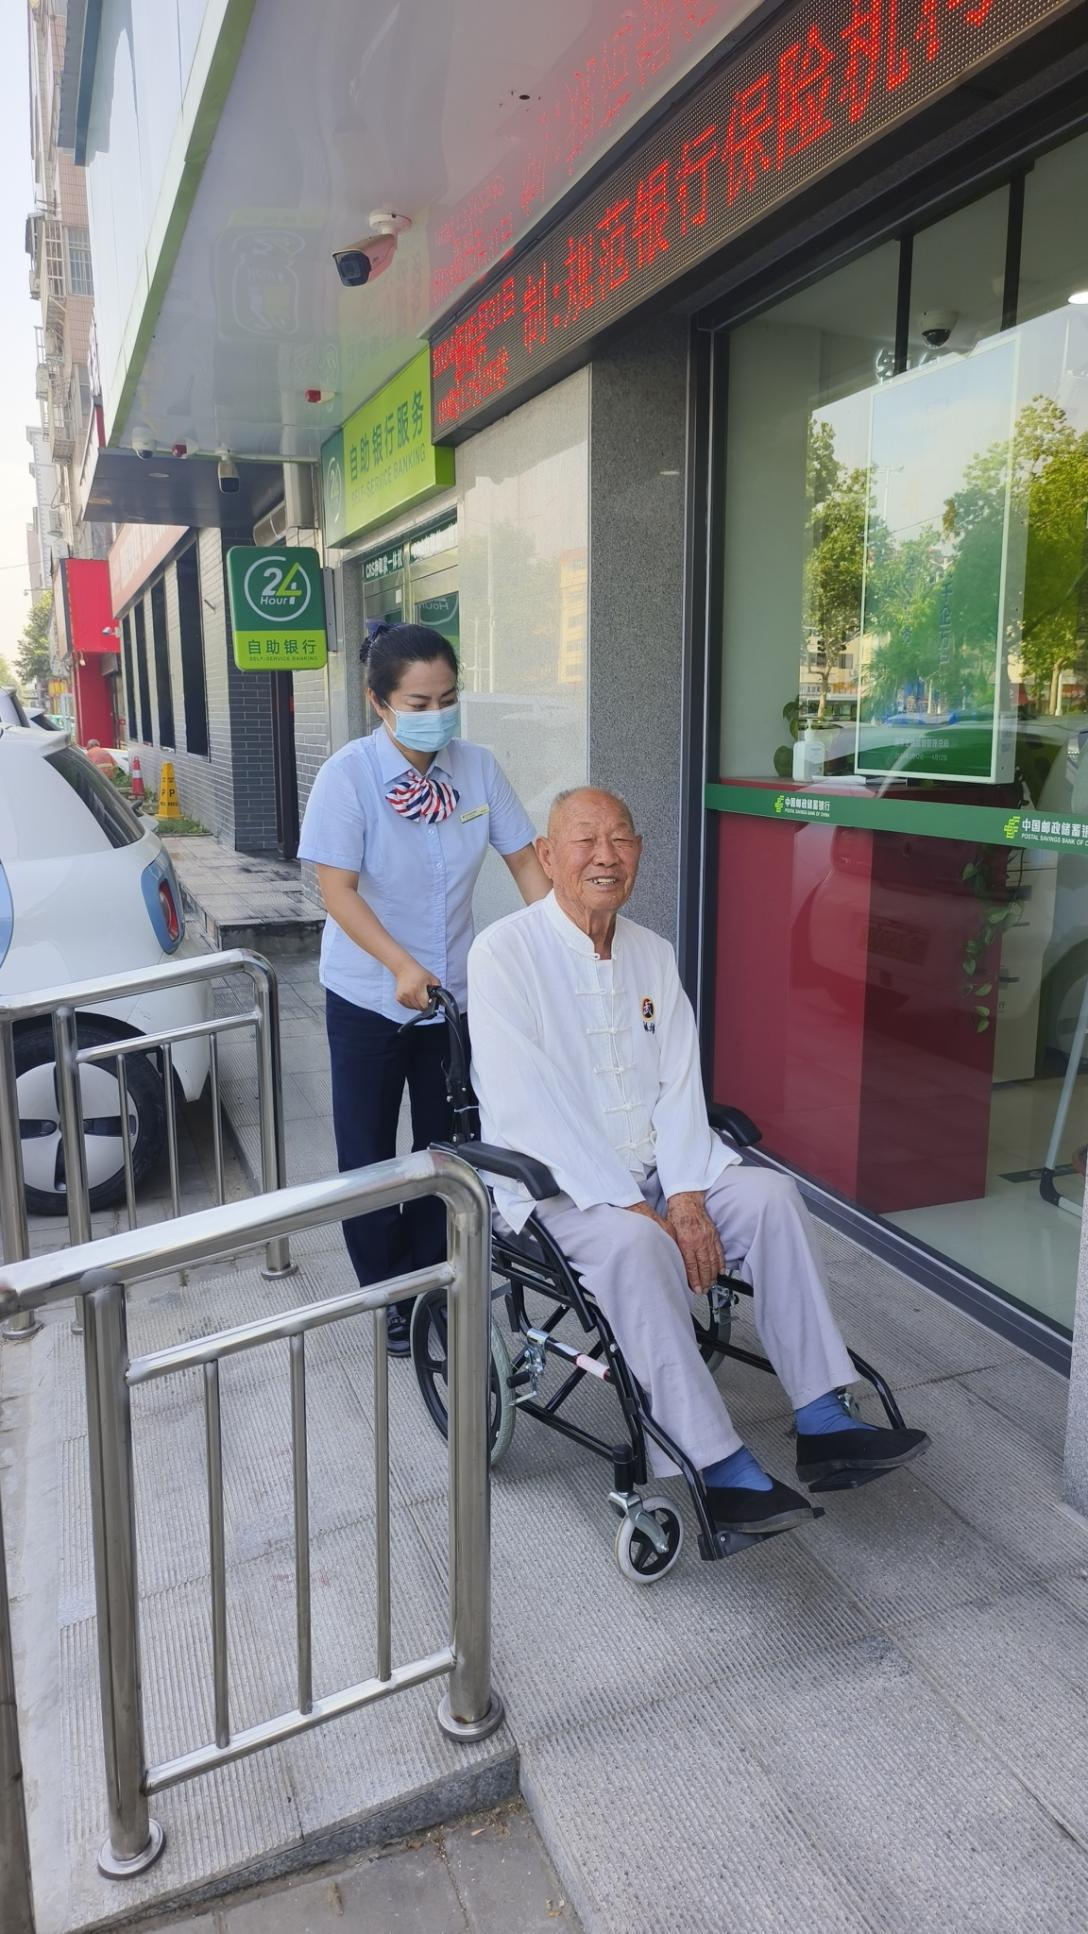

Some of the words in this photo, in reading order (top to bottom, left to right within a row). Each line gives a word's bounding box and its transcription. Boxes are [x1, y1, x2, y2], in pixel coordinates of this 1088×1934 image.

[350, 390, 424, 481] 自助银行服务
[262, 562, 302, 601] 24
[260, 597, 287, 605] Hour
[248, 640, 316, 654] 自助银行
[1040, 835, 1060, 843] SAVINGS
[1061, 837, 1075, 845] BANK
